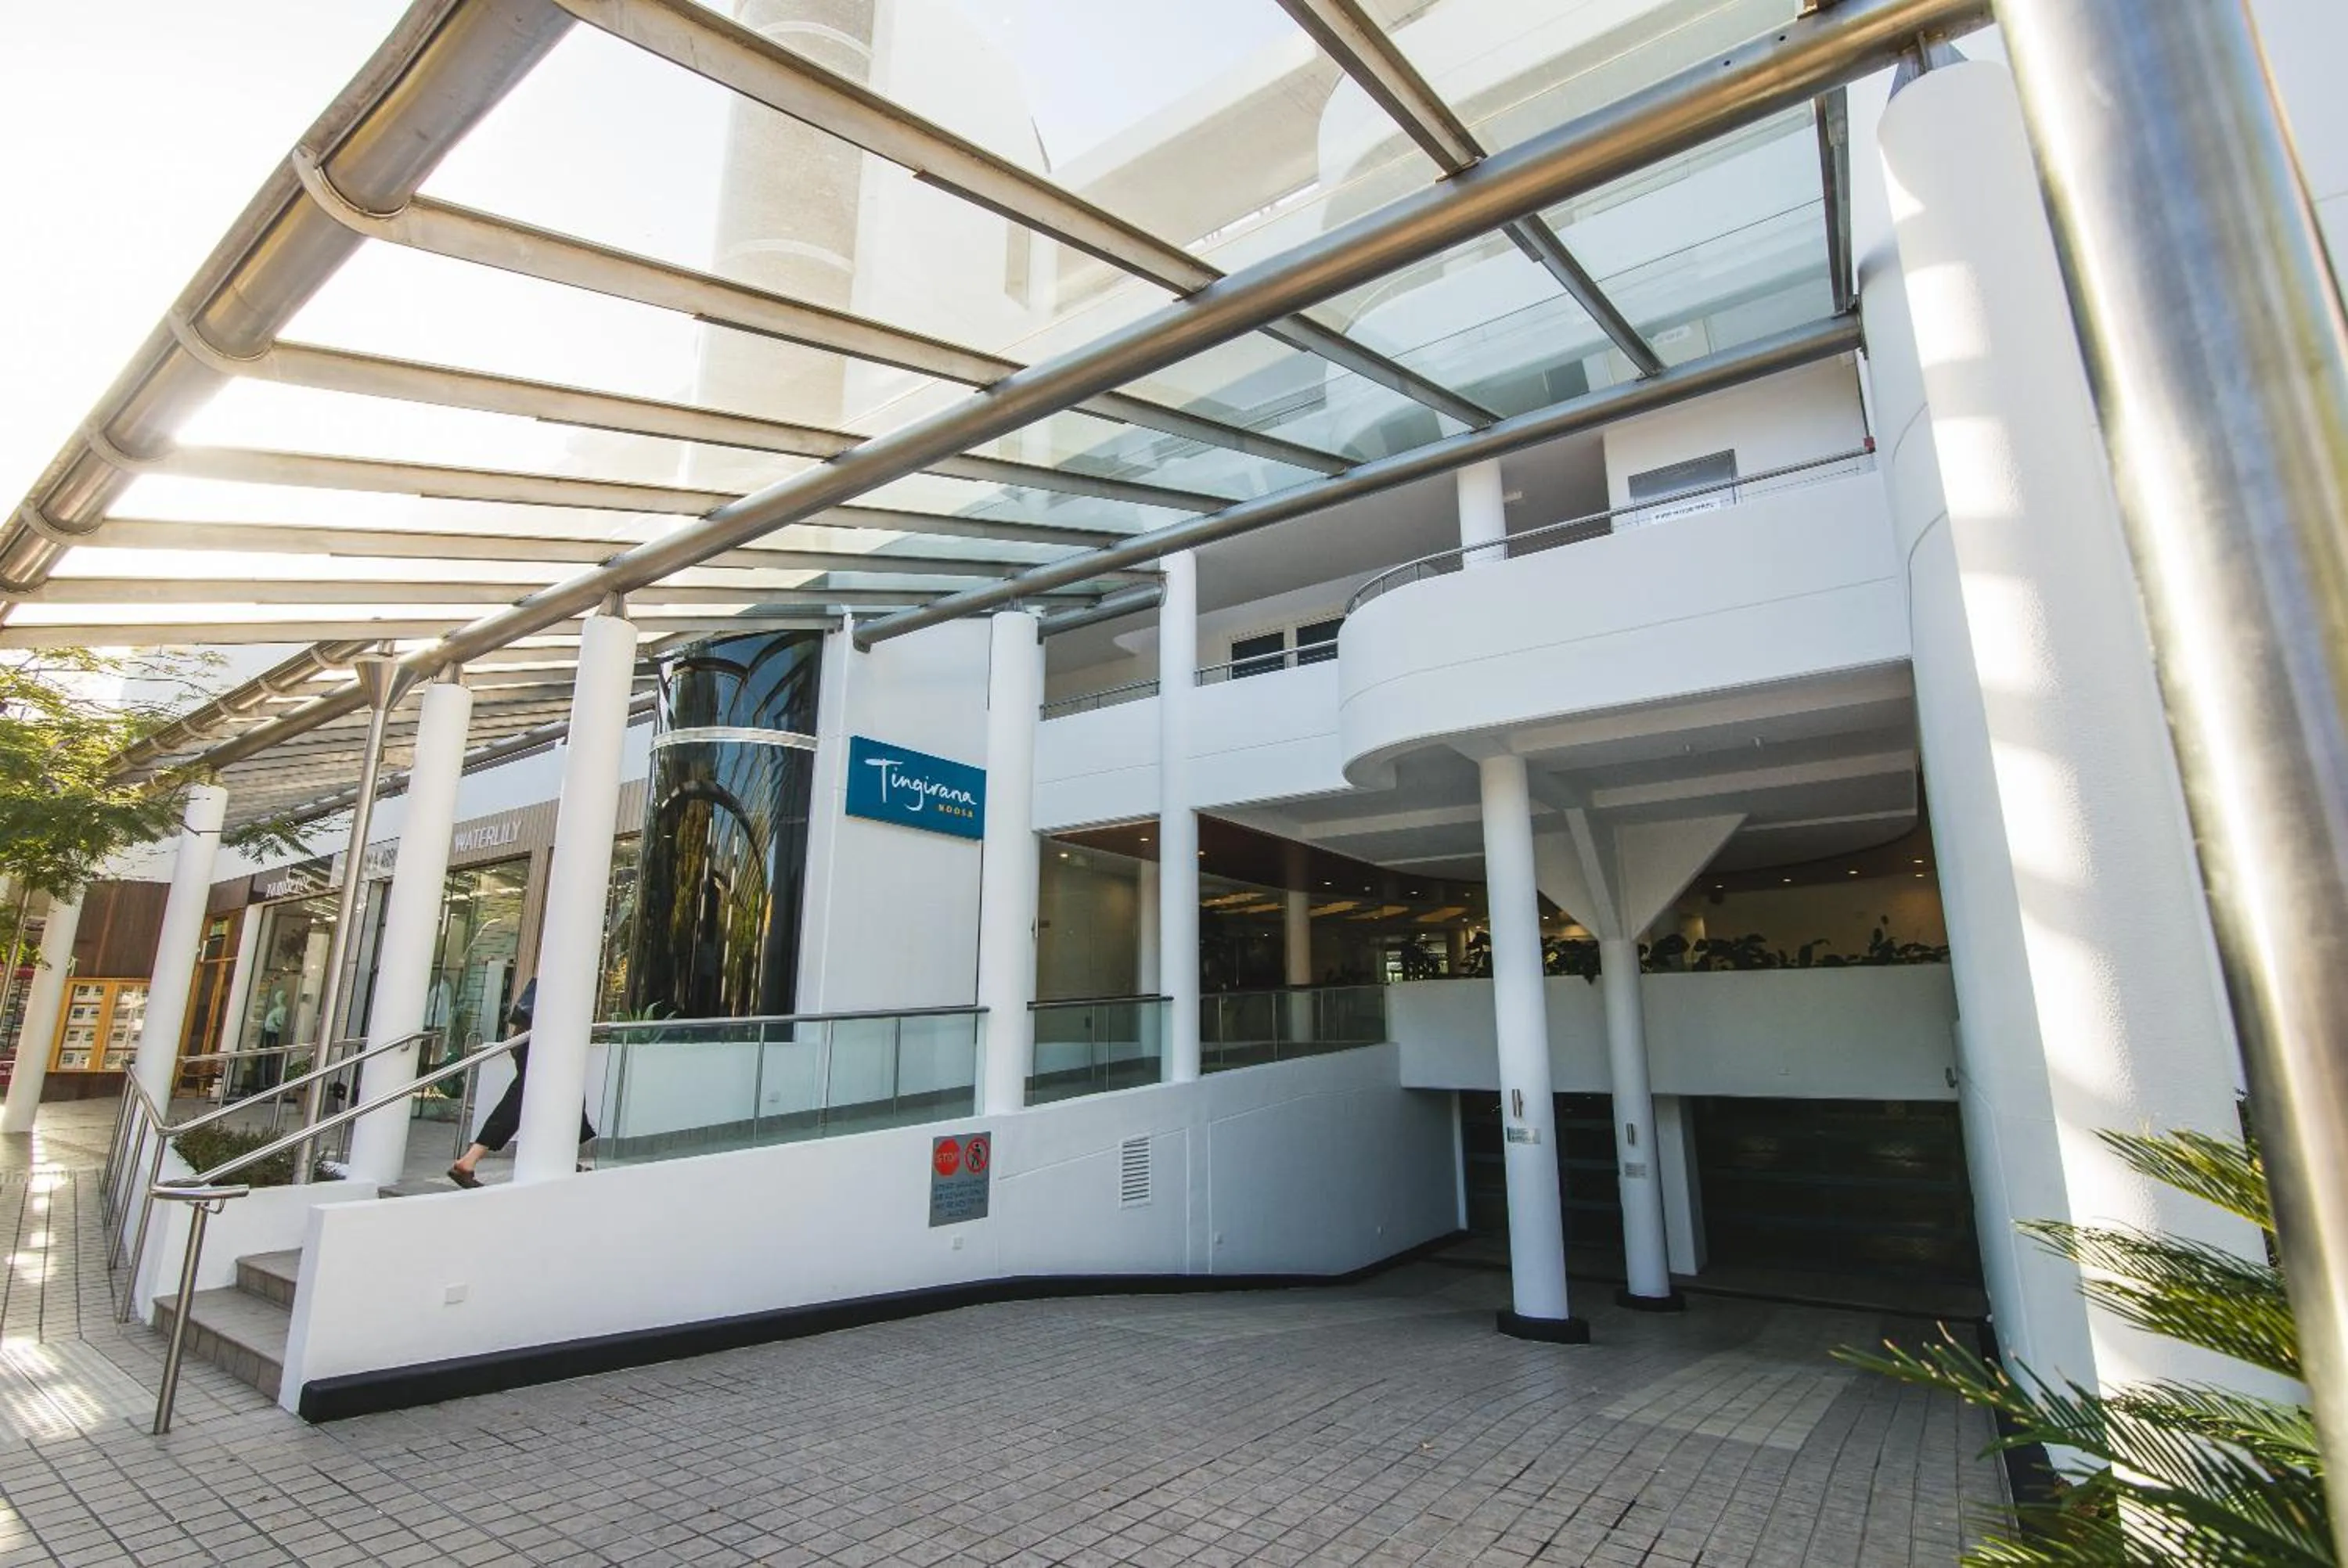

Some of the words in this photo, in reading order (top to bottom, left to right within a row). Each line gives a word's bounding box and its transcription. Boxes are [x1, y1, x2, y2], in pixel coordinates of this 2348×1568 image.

[864, 758, 977, 811] Tingirana
[938, 804, 974, 818] NOOSA
[455, 819, 522, 854] WATERLILY
